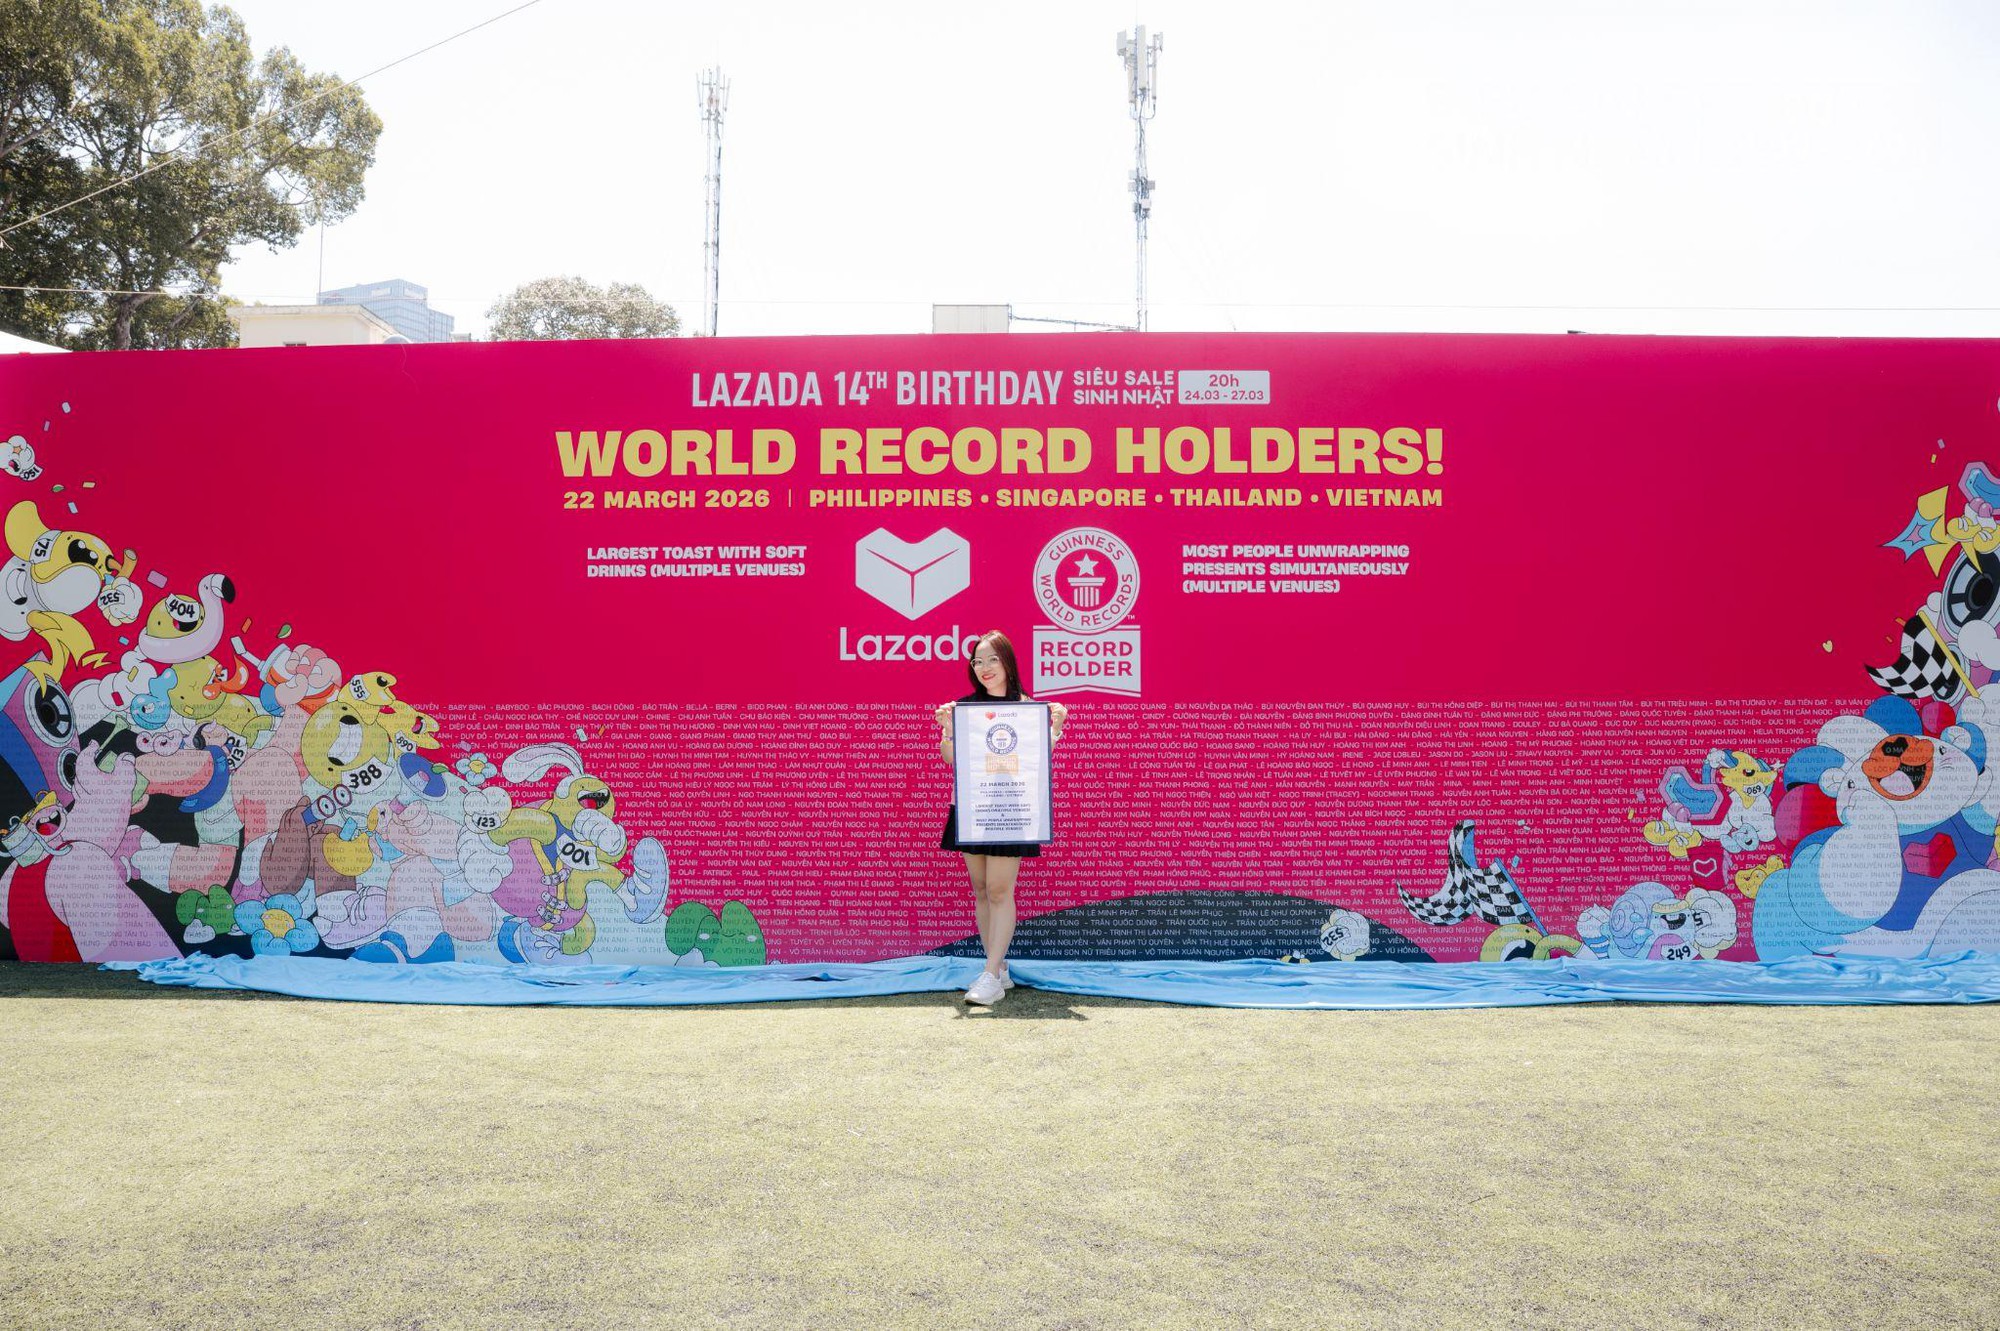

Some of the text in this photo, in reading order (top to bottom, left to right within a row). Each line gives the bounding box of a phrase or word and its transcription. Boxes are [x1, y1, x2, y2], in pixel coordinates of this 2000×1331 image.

[1074, 367, 1174, 386] SIÊU SALE
[1209, 374, 1239, 387] 20h
[693, 372, 822, 406] LAZADA
[897, 371, 1063, 405] BIRTHDAY
[1185, 390, 1219, 400] 24.03
[1232, 390, 1263, 400] 27.03
[1073, 388, 1173, 408] SINH NHẬT
[556, 426, 1443, 477] WORLD RECORD HOLDERS!
[564, 488, 1442, 509] 22 MARCH 2026 PHILIPPINES SINGAPORE THAILAND VIETNAM
[588, 546, 806, 559] LARGEST TOAST WITH SOFT
[1050, 535, 1124, 561] GUINNESS
[1183, 545, 1409, 558] MOST PEOPLE UNWRAPPING
[588, 563, 805, 577] DRINKS (MULTIPLE VENUES)
[1183, 563, 1409, 575] PRESENTS SIMULTANEOUSLY
[1183, 580, 1340, 593] (MULTIPLE VENUES)
[1041, 574, 1132, 626] WORLD RECORDS
[169, 598, 195, 617] 404
[1041, 642, 1132, 656] RECORD
[1041, 662, 1132, 676] HOLDER
[1375, 741, 1388, 749] KIM
[1390, 741, 1406, 749] ANH
[348, 764, 382, 789] 388
[1398, 780, 1413, 788] MAY
[774, 810, 789, 818] HUY
[1273, 810, 1287, 818] LAN
[477, 816, 496, 828] 123
[1329, 839, 1348, 847] MINH
[1350, 839, 1375, 847] TRANG
[1667, 946, 1691, 961] 249
